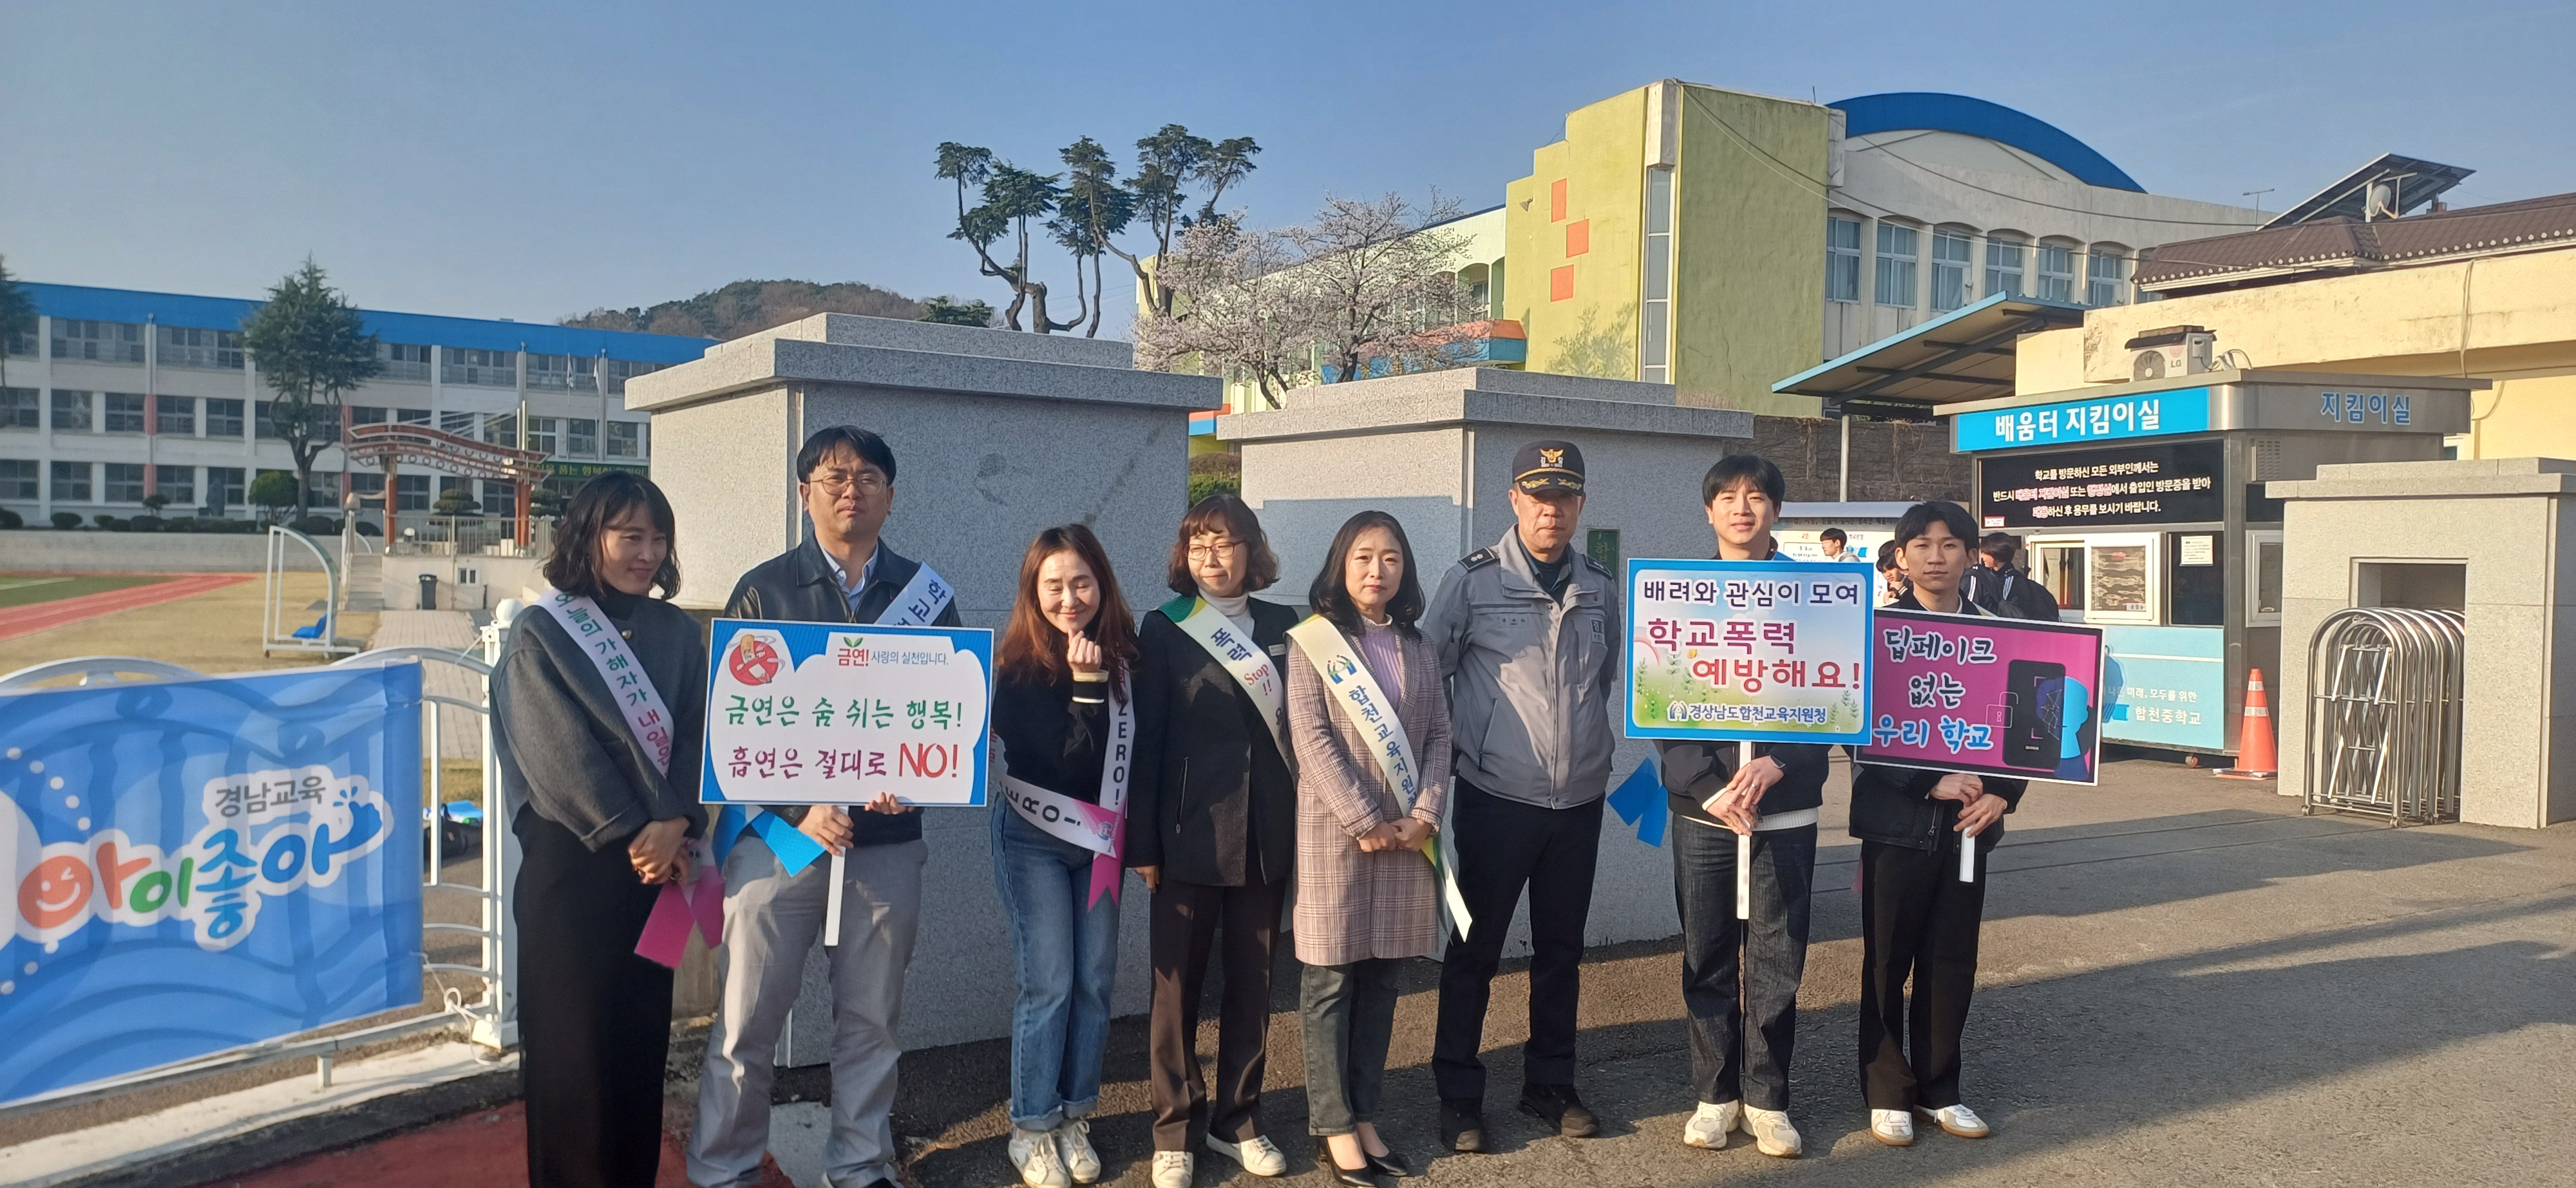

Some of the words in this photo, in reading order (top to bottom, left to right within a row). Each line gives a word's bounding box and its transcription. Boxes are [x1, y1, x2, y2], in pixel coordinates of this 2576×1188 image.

[2171, 359, 2182, 368] LG
[1996, 410, 2058, 443] 배움터
[2065, 399, 2161, 436] 지킴이실
[2320, 392, 2411, 425] 지킴이실
[2034, 469, 2058, 481] 학교를
[2058, 466, 2090, 479] 방문하신
[2091, 465, 2107, 477] 모든
[2108, 461, 2159, 476] 외부인께서는
[1993, 490, 2015, 502] 반드시
[2038, 485, 2069, 501] 지킴이실
[2070, 486, 2086, 497] 또는
[2128, 481, 2154, 494] 출입인
[2155, 478, 2191, 492] 방문증을
[2192, 477, 2211, 490] 받아
[2064, 504, 2072, 517] 후
[2074, 504, 2098, 516] 용무를
[2098, 501, 2123, 515] 보시기
[2125, 500, 2161, 513] 바랍니다.
[1643, 580, 1718, 604] 배려와
[1725, 581, 1800, 605] 관심이
[1810, 582, 1859, 606] 모여
[555, 592, 603, 637] 오늘의
[594, 638, 648, 707] 가해자가
[1211, 627, 1253, 662] 폭력
[1647, 618, 1797, 655] 학교폭력
[1884, 627, 1995, 663] 딥페이크
[837, 648, 870, 667] 금연!
[871, 651, 900, 665] 사랑의
[901, 652, 949, 666] 실천입니다.
[1244, 664, 1269, 686] Stop
[1692, 660, 1861, 693] 예방해요!
[1910, 674, 1964, 707] 없는
[2126, 687, 2148, 699] 미래,
[2150, 689, 2176, 702] 모두를
[2179, 691, 2197, 703] 위한
[724, 695, 800, 727] 금연은
[811, 696, 835, 727] 숨
[846, 698, 894, 729] 쉬는
[906, 700, 963, 731] 행복!
[1689, 704, 1828, 724] 경상남도합천교육지원청
[2135, 706, 2202, 725] 합천중학교
[1873, 716, 1928, 747] 우리
[1940, 716, 1991, 752] 학교
[728, 745, 803, 780] 흡연은
[815, 749, 887, 780] 절대로
[899, 742, 958, 779] NO!
[216, 775, 326, 818] 경남교육
[999, 781, 1081, 827] ERO!
